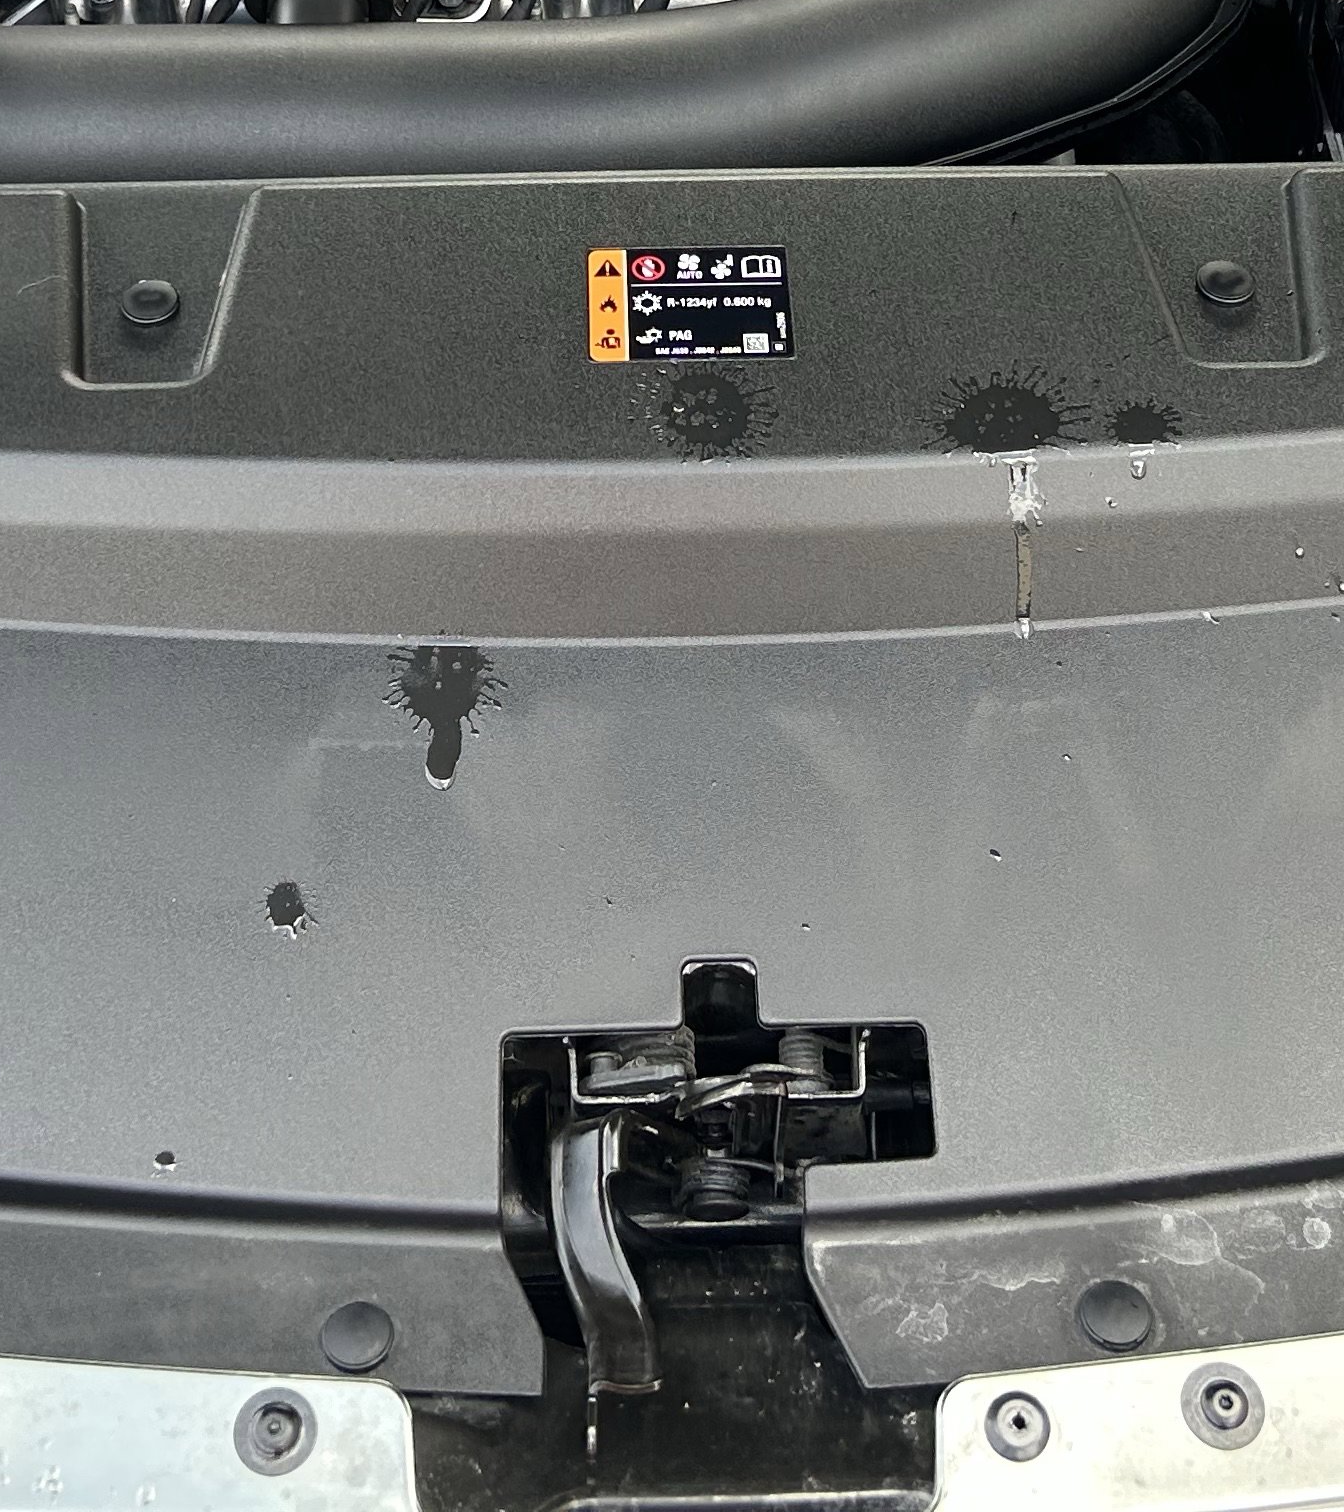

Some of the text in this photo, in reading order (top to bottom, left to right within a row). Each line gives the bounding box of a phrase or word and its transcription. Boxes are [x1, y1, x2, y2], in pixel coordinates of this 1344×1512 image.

[676, 270, 702, 281] AUTO
[666, 296, 718, 309] R-1234yf
[757, 296, 772, 308] kg
[668, 330, 693, 342] PAG
